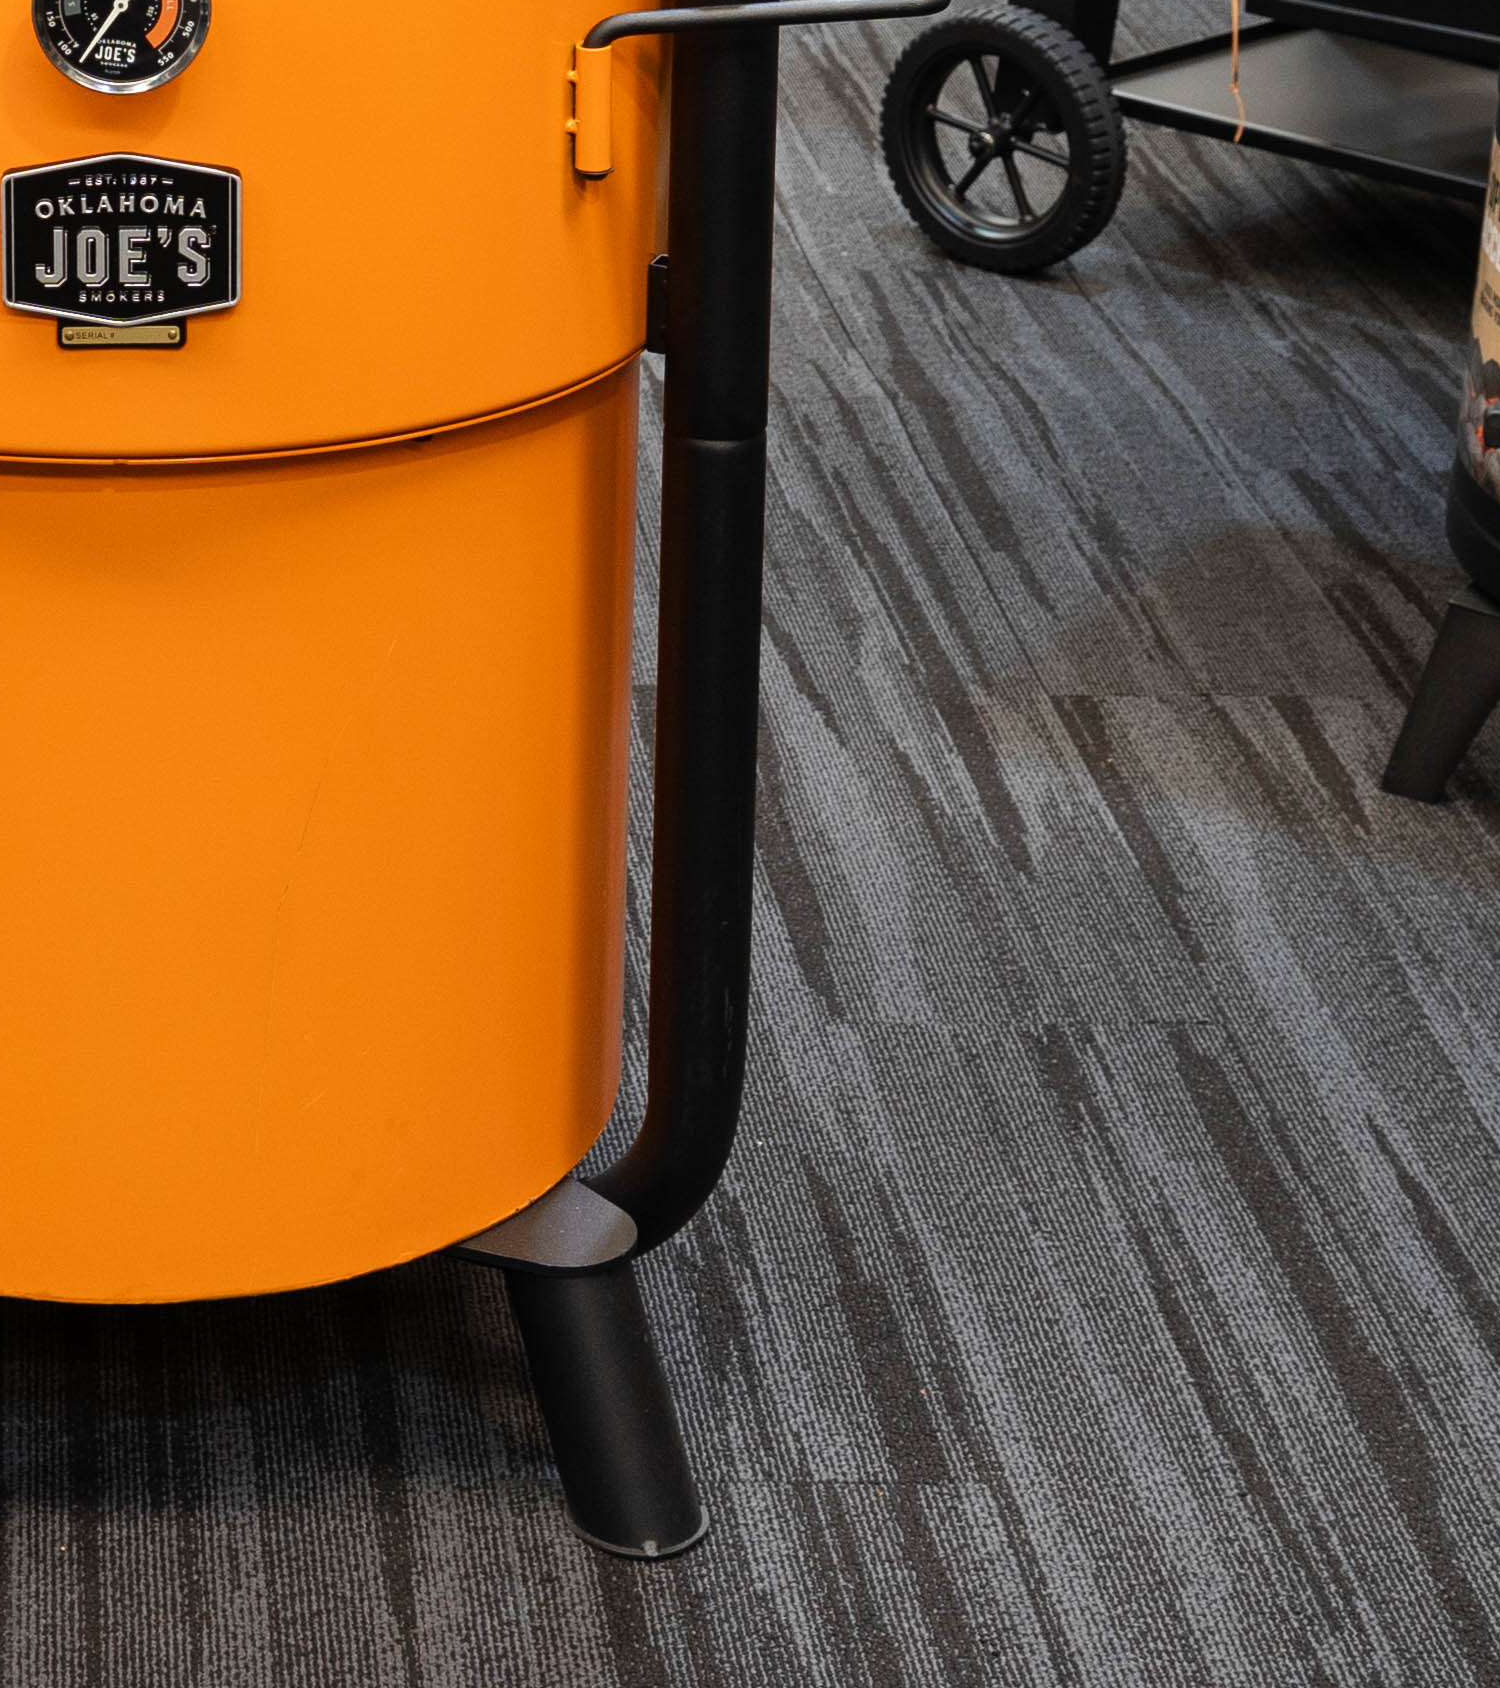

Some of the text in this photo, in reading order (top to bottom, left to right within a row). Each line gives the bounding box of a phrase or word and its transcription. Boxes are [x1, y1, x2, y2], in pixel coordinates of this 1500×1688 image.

[45, 11, 56, 28] 150
[181, 20, 195, 38] 500
[57, 40, 73, 56] 100
[94, 45, 137, 63] JOE'S
[157, 52, 175, 67] 550
[84, 174, 159, 187] EST. 1987
[34, 195, 209, 220] OKLAHOMA
[34, 226, 212, 289] JOE'S
[78, 290, 166, 304] SMOKERS
[75, 330, 109, 341] SERIAL
